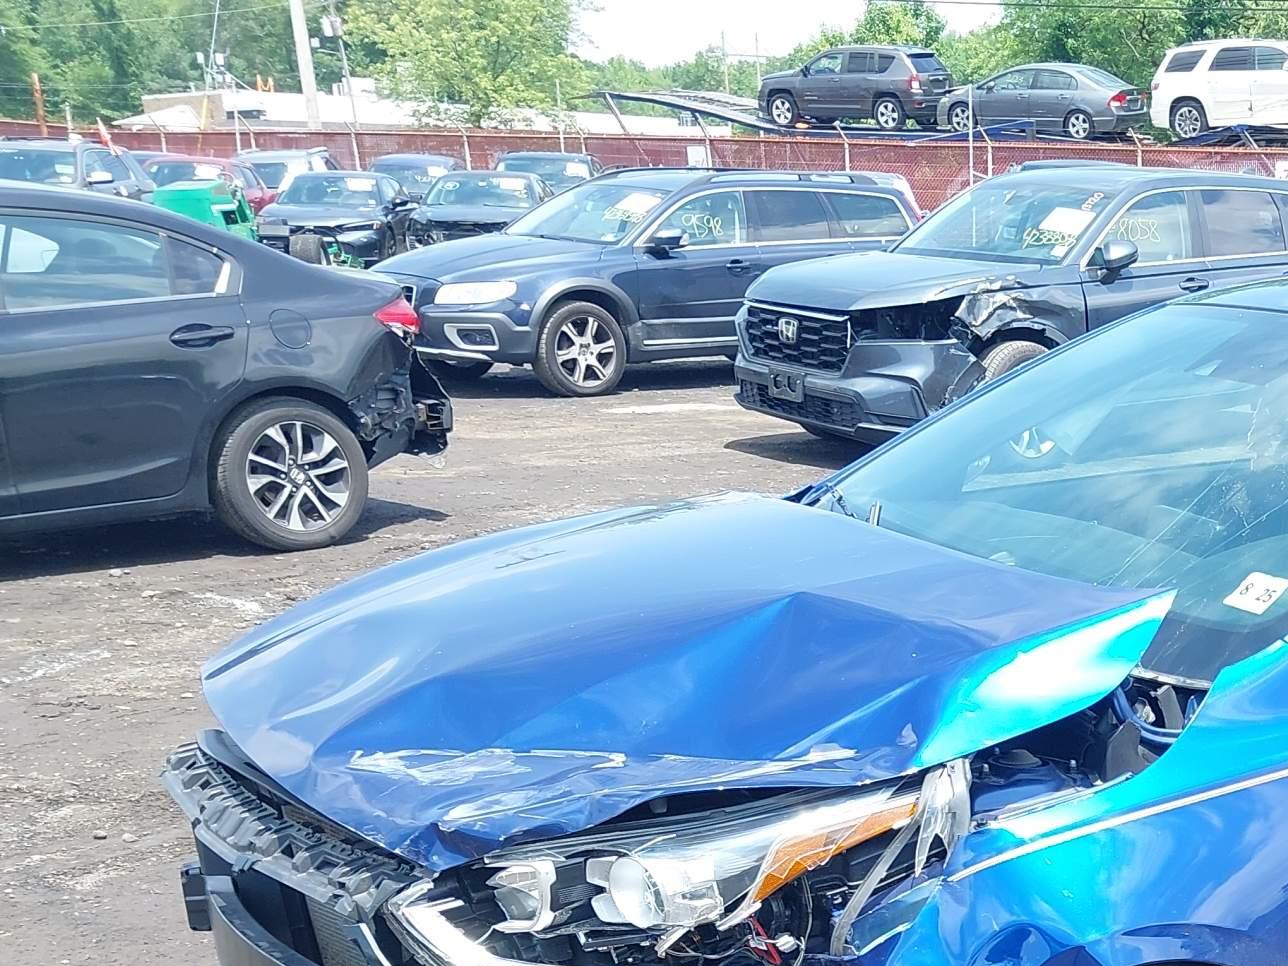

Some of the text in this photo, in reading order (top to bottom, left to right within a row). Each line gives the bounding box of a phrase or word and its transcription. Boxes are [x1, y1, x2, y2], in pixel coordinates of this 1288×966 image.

[681, 214, 725, 240] 9598
[1239, 582, 1277, 603] 8 25
